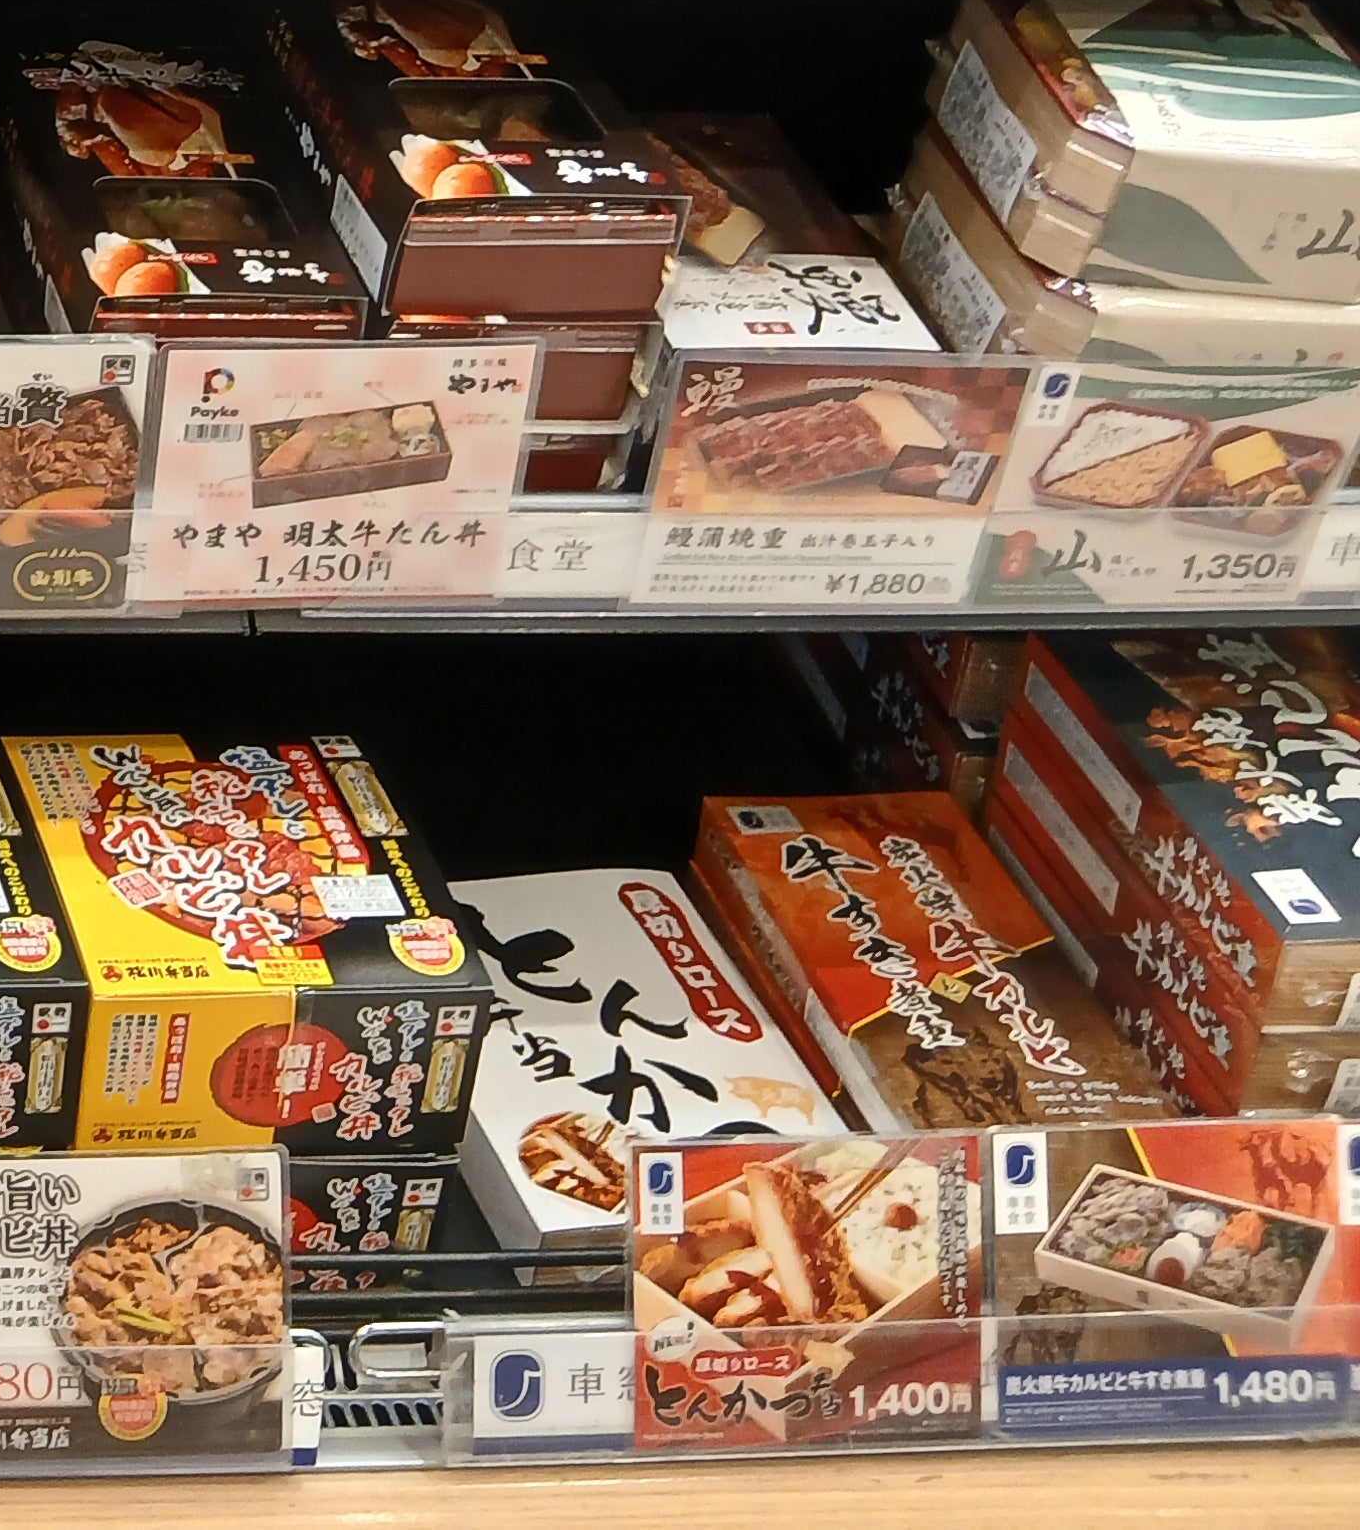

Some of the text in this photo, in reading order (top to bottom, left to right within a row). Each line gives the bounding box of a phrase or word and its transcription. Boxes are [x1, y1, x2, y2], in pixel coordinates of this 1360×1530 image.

[172, 523, 263, 550] やまや
[284, 519, 487, 547] 明太牛たん丼
[664, 526, 790, 550] 鰻蒲焼重
[255, 551, 392, 586] 1,450円
[507, 537, 593, 572] 食堂
[1182, 554, 1298, 583] 1,350円
[824, 572, 927, 596] ¥1,880
[646, 1365, 816, 1429] とんかつ
[848, 1381, 973, 1419] 1,400円
[1214, 1370, 1336, 1408] 1,480円
